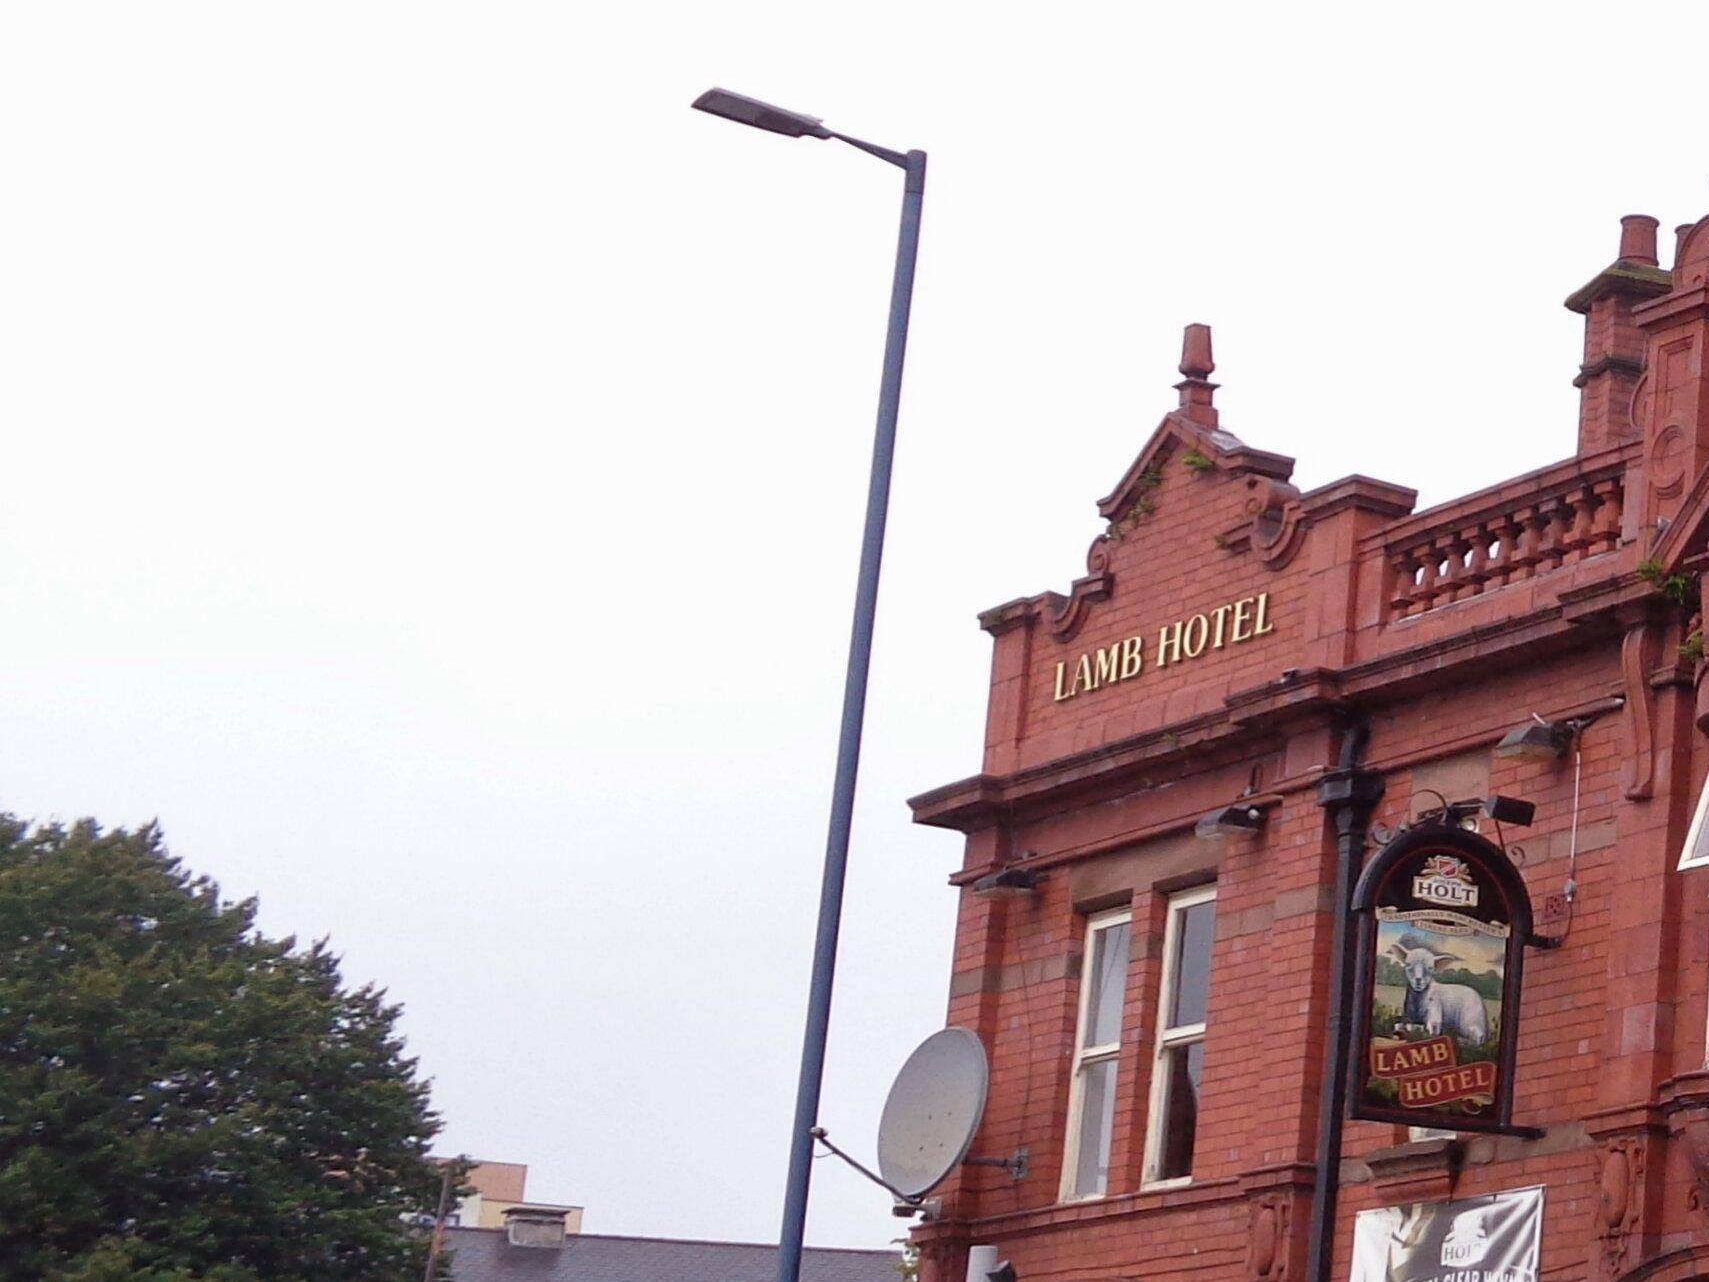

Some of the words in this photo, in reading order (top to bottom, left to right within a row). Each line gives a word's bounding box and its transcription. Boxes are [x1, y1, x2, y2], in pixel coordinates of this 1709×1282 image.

[1053, 635, 1142, 702] LAMB
[1156, 592, 1273, 668] HOTEL
[1418, 882, 1475, 902] HOLT
[1377, 1043, 1448, 1072] LAMB
[1405, 1068, 1489, 1101] HOTEL
